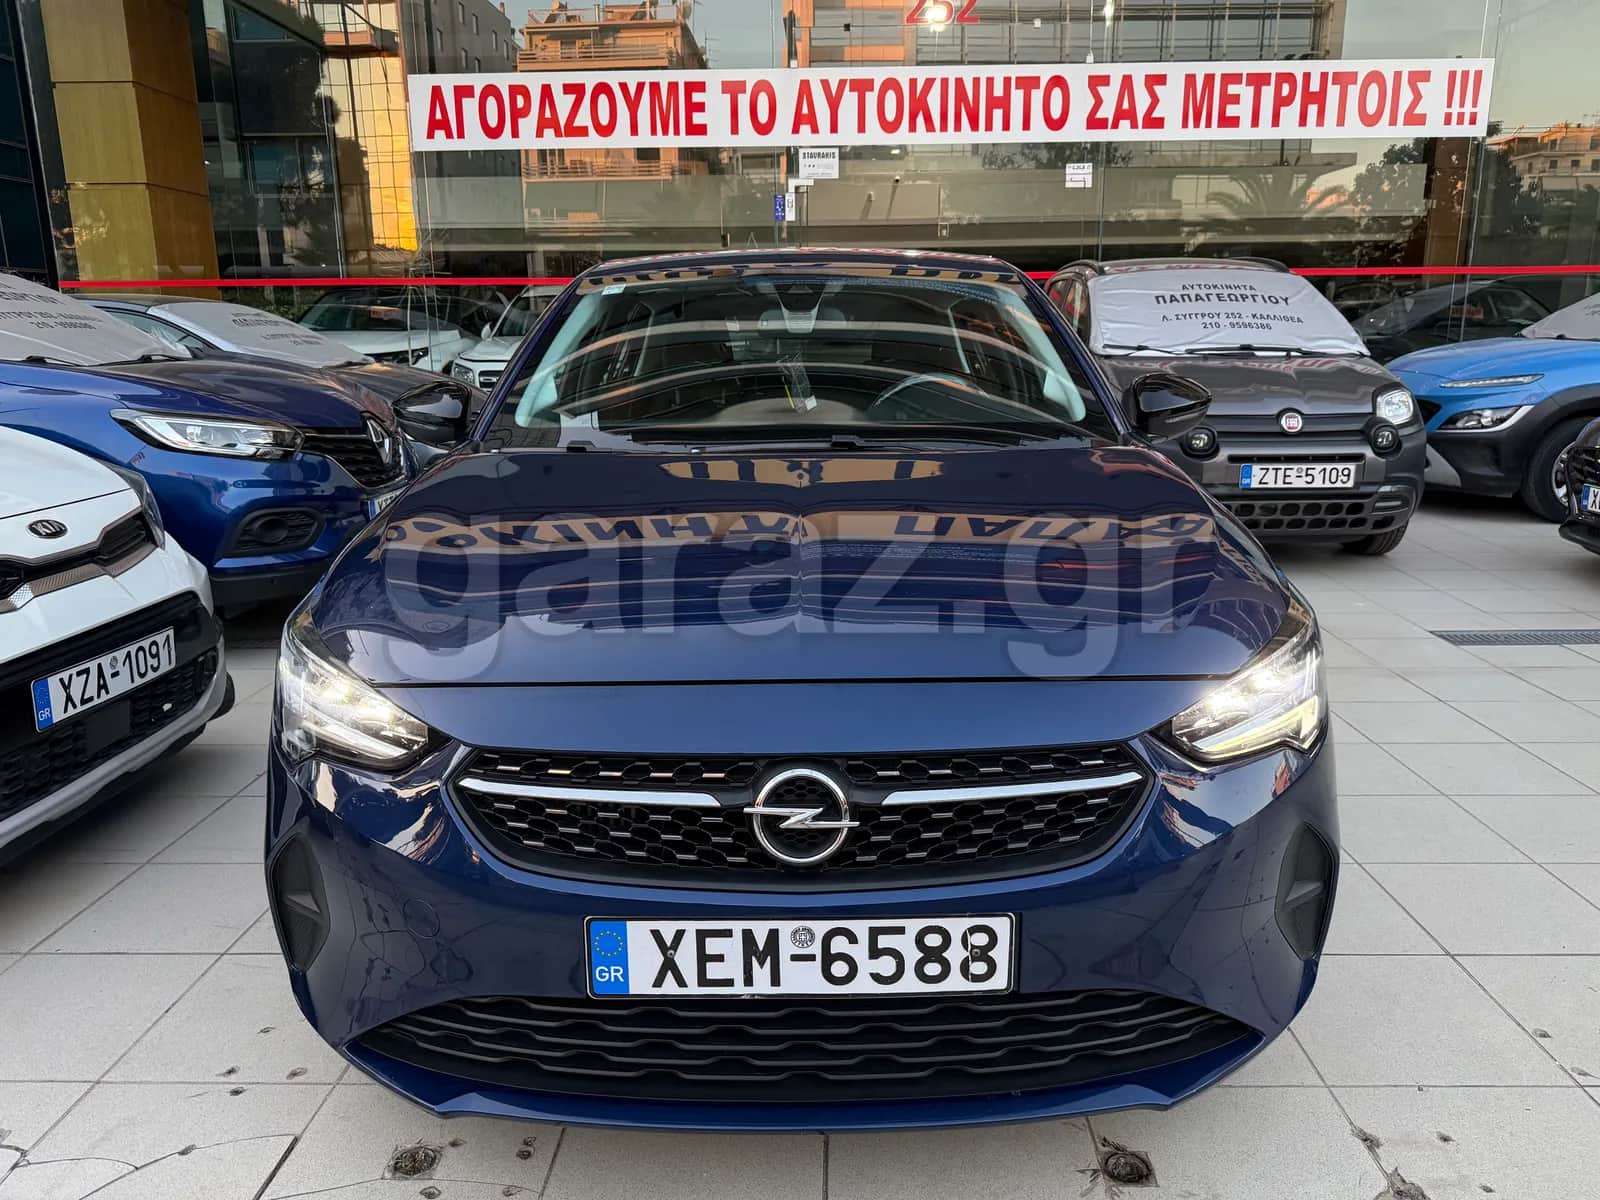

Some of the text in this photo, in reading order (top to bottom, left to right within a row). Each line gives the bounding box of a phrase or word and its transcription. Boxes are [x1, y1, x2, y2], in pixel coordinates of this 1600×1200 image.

[426, 70, 1483, 140] ΑΓΟΡΑΖΟΥΜΕ ΤΟ ΑΥΤΟΚΙΝΗΤΟ ΣΑΣ ΜΕΤΡΗΤΟΙΣ !!!
[1154, 293, 1289, 306] ΠΑΠΑΓΕΩΡΓΙΟΥ
[1174, 313, 1221, 321] ΣΥΓΓΡΟΥ
[1251, 313, 1304, 323] ΚΑΛΛΙΘΕΑ
[1258, 467, 1351, 485] ZTE-5109
[32, 521, 65, 536] KIA
[59, 634, 172, 714] XZA-1091
[38, 709, 50, 720] GR
[651, 924, 998, 988] XEM-6588
[595, 966, 624, 982] GR
